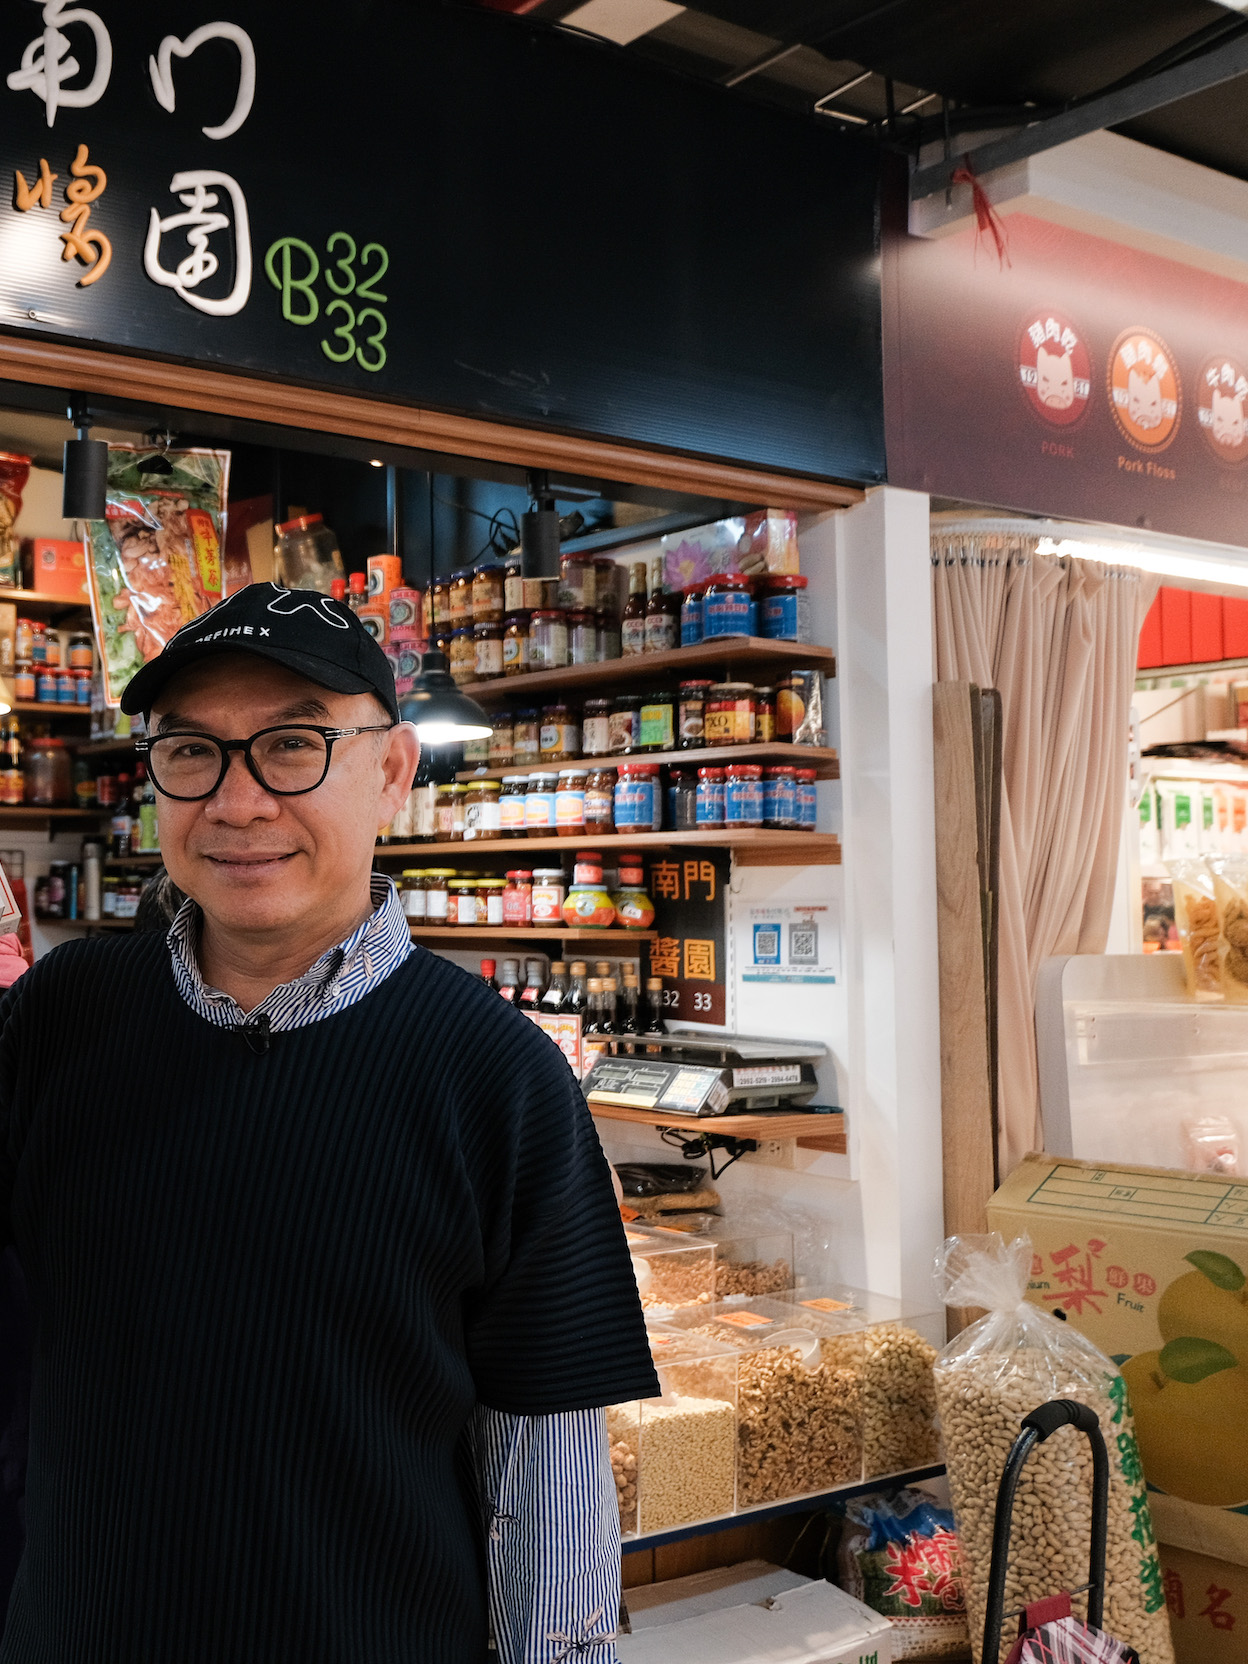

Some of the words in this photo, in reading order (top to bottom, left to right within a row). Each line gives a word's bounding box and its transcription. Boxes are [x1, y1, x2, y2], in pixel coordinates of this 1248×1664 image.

[325, 232, 389, 303] 32
[321, 300, 387, 372] 33
[1117, 456, 1144, 473] Pork
[1147, 461, 1176, 480] Floss
[708, 715, 728, 728] XO
[650, 860, 716, 901] 南門
[649, 937, 716, 982] 醬園
[693, 992, 712, 1012] 33
[1117, 1293, 1145, 1313] Fruit
